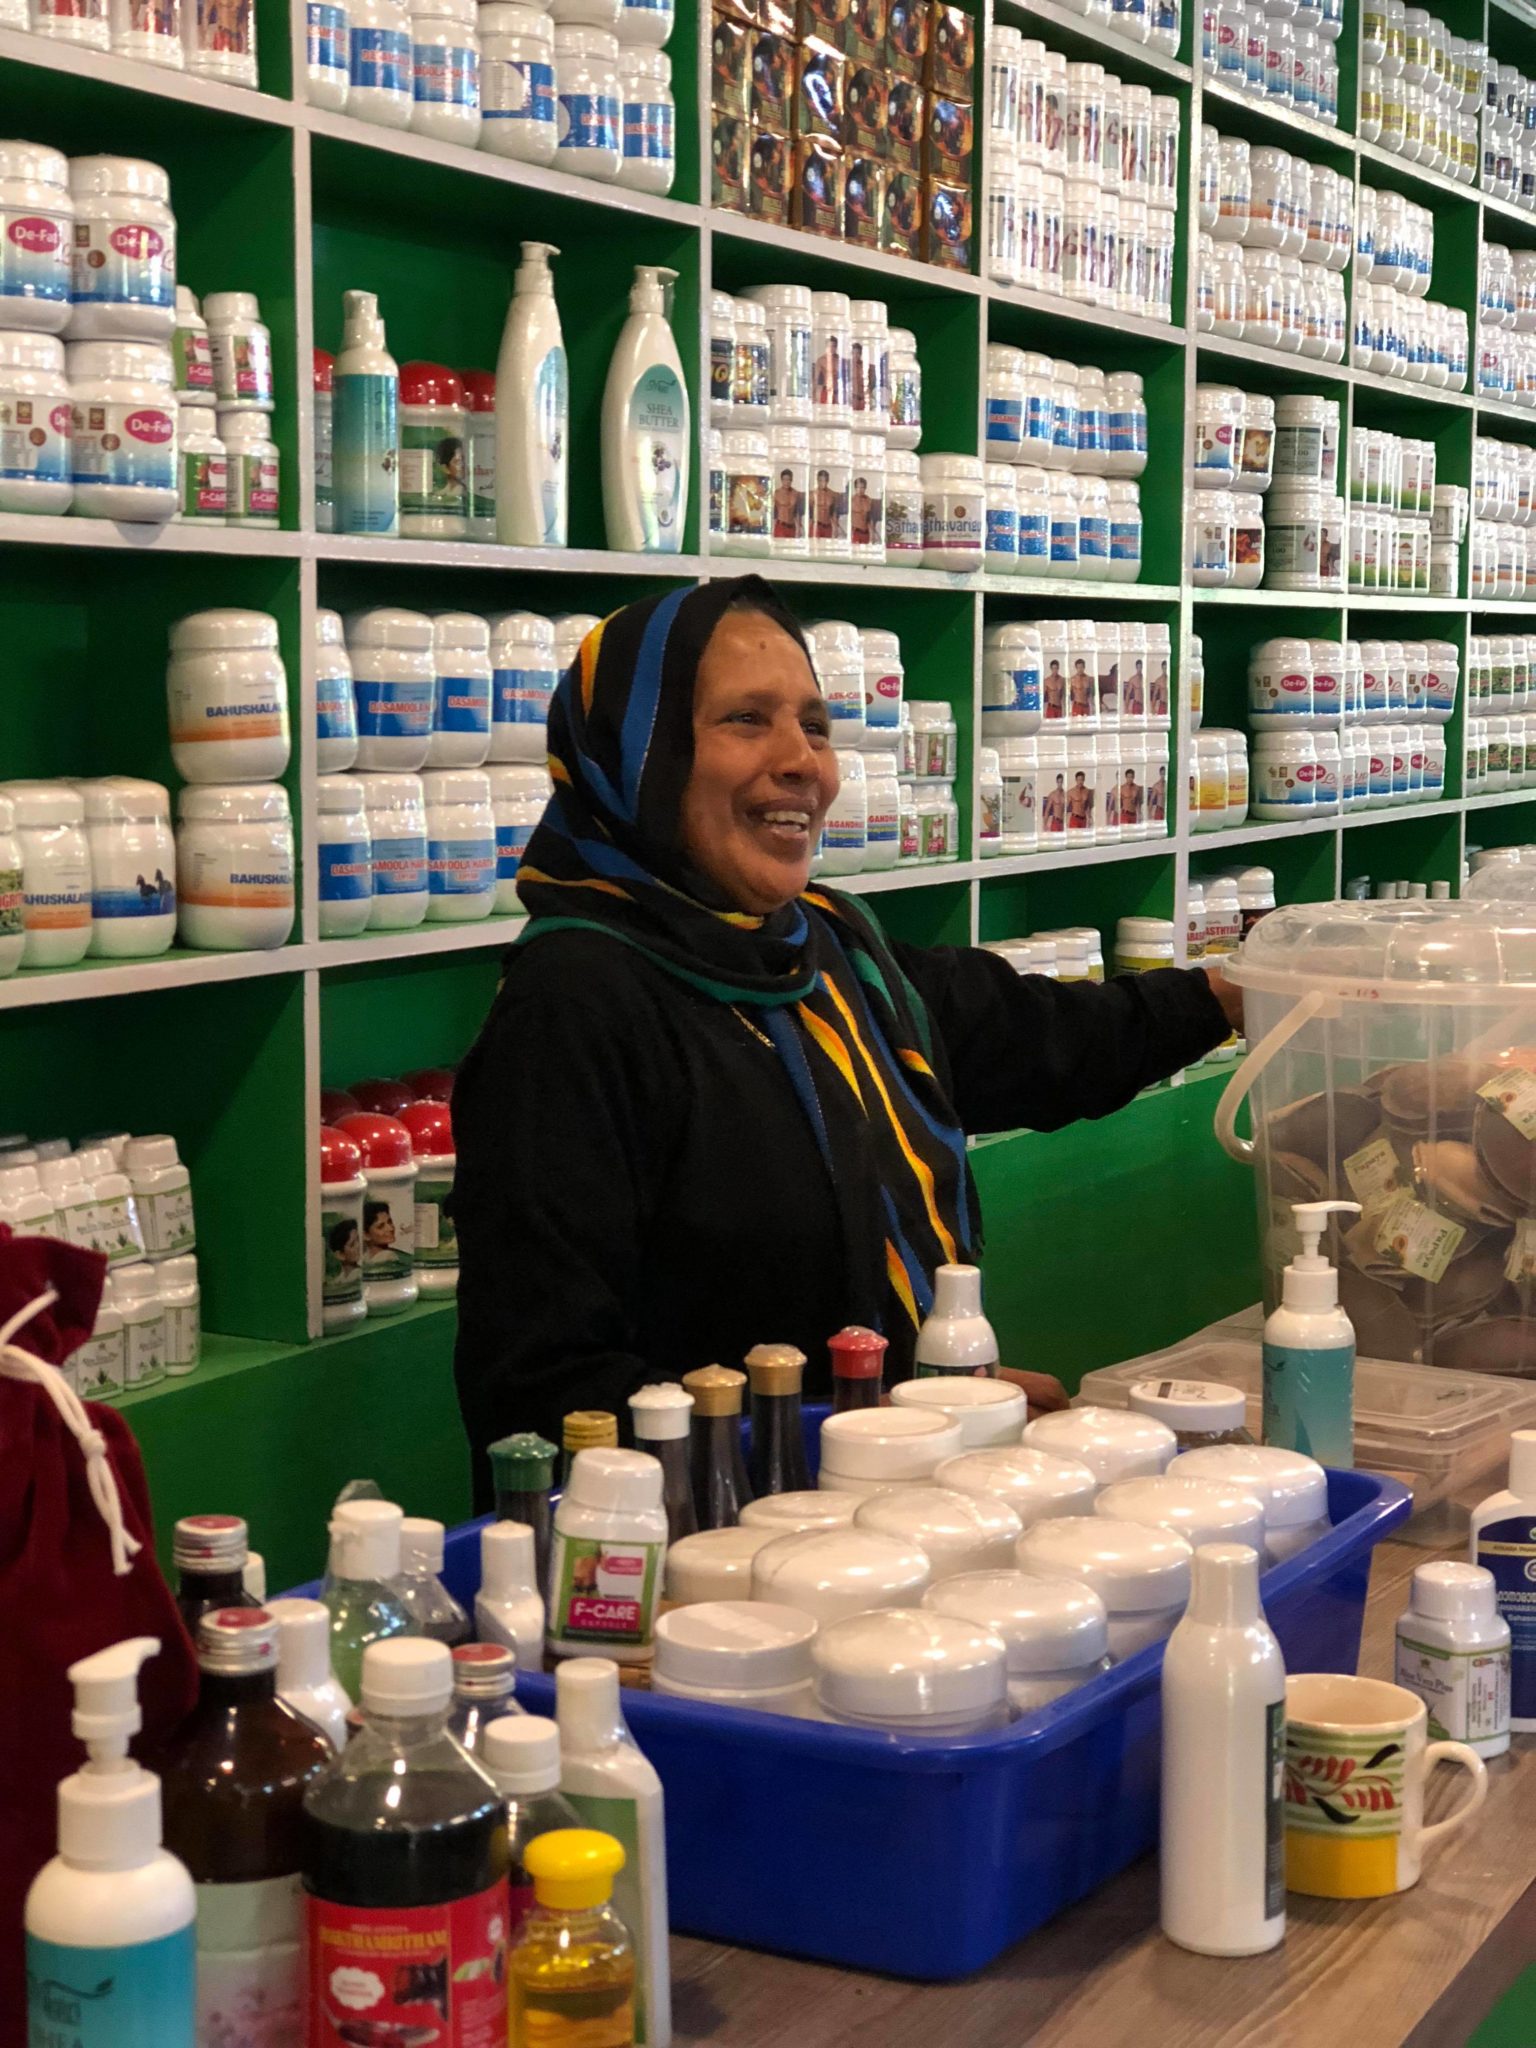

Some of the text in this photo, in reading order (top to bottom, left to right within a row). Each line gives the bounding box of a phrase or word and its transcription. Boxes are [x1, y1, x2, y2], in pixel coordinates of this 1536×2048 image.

[117, 234, 160, 250] De-at
[646, 403, 673, 416] SHEA
[638, 414, 680, 428] BUTTER
[574, 1601, 637, 1621] F-CARE
